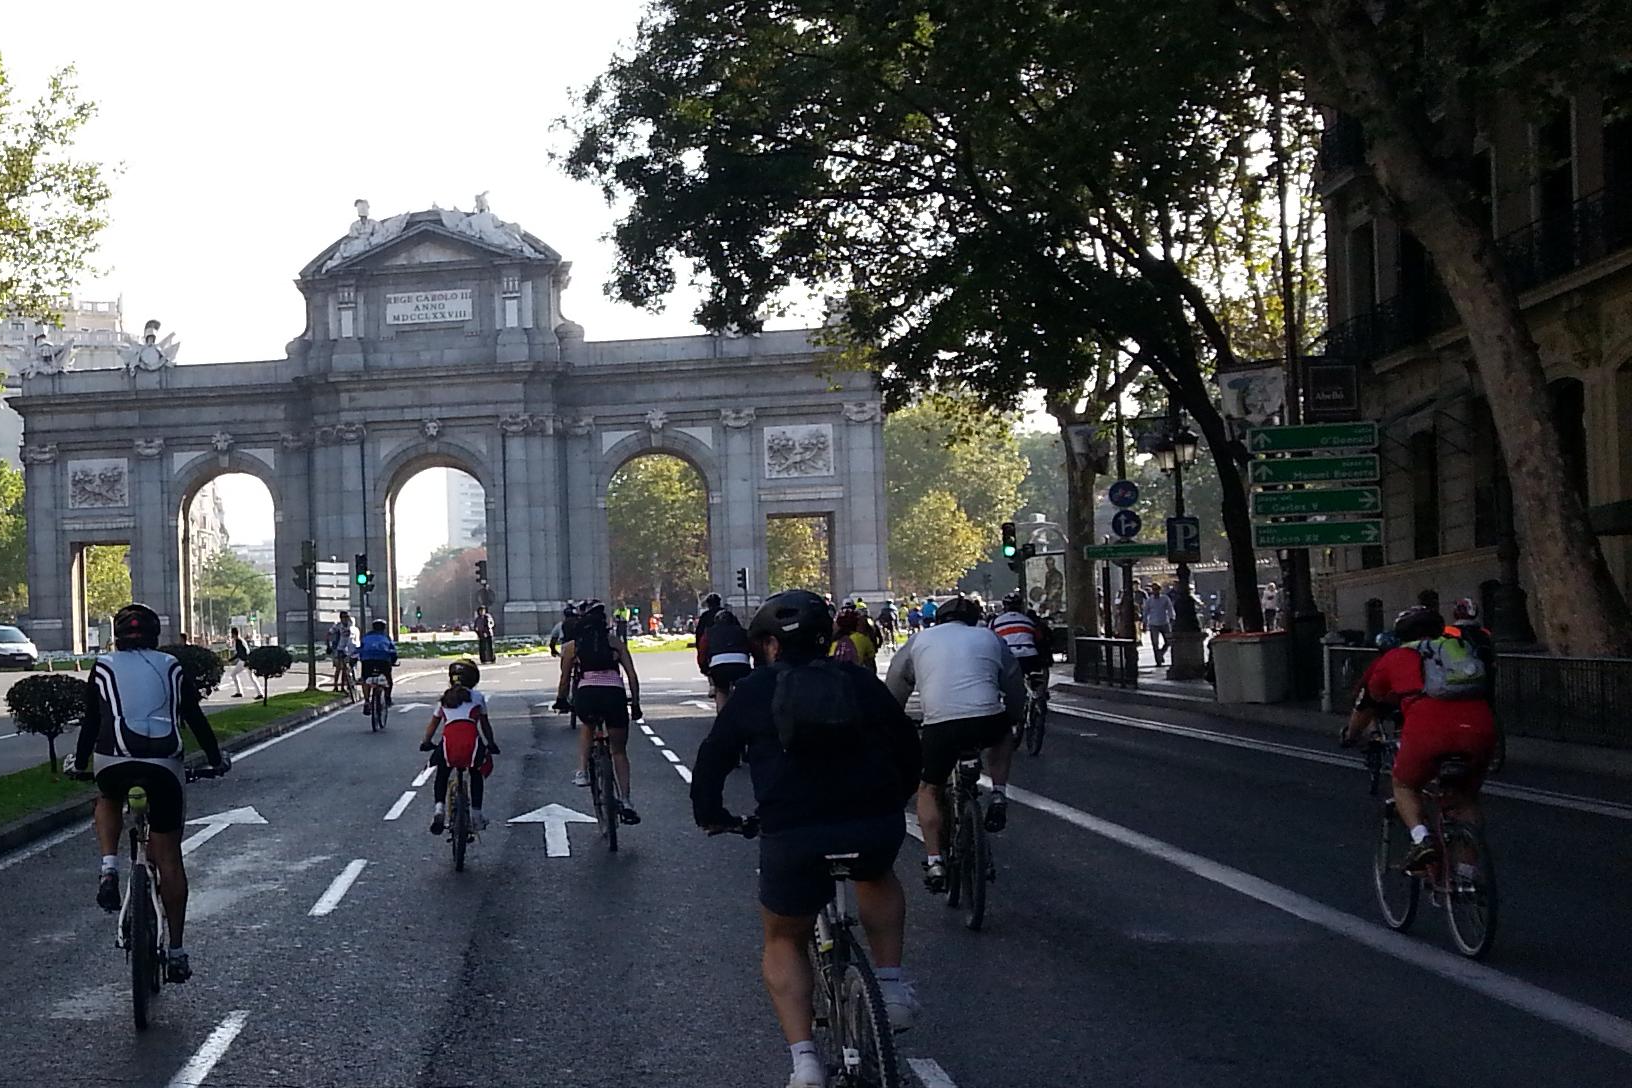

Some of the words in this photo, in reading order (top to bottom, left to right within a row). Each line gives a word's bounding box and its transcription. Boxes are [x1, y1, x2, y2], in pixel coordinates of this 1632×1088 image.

[415, 293, 458, 303] CAROLO
[414, 303, 445, 312] ANNO
[392, 310, 466, 322] MDCCLXXVIII
[1172, 523, 1197, 551] P
